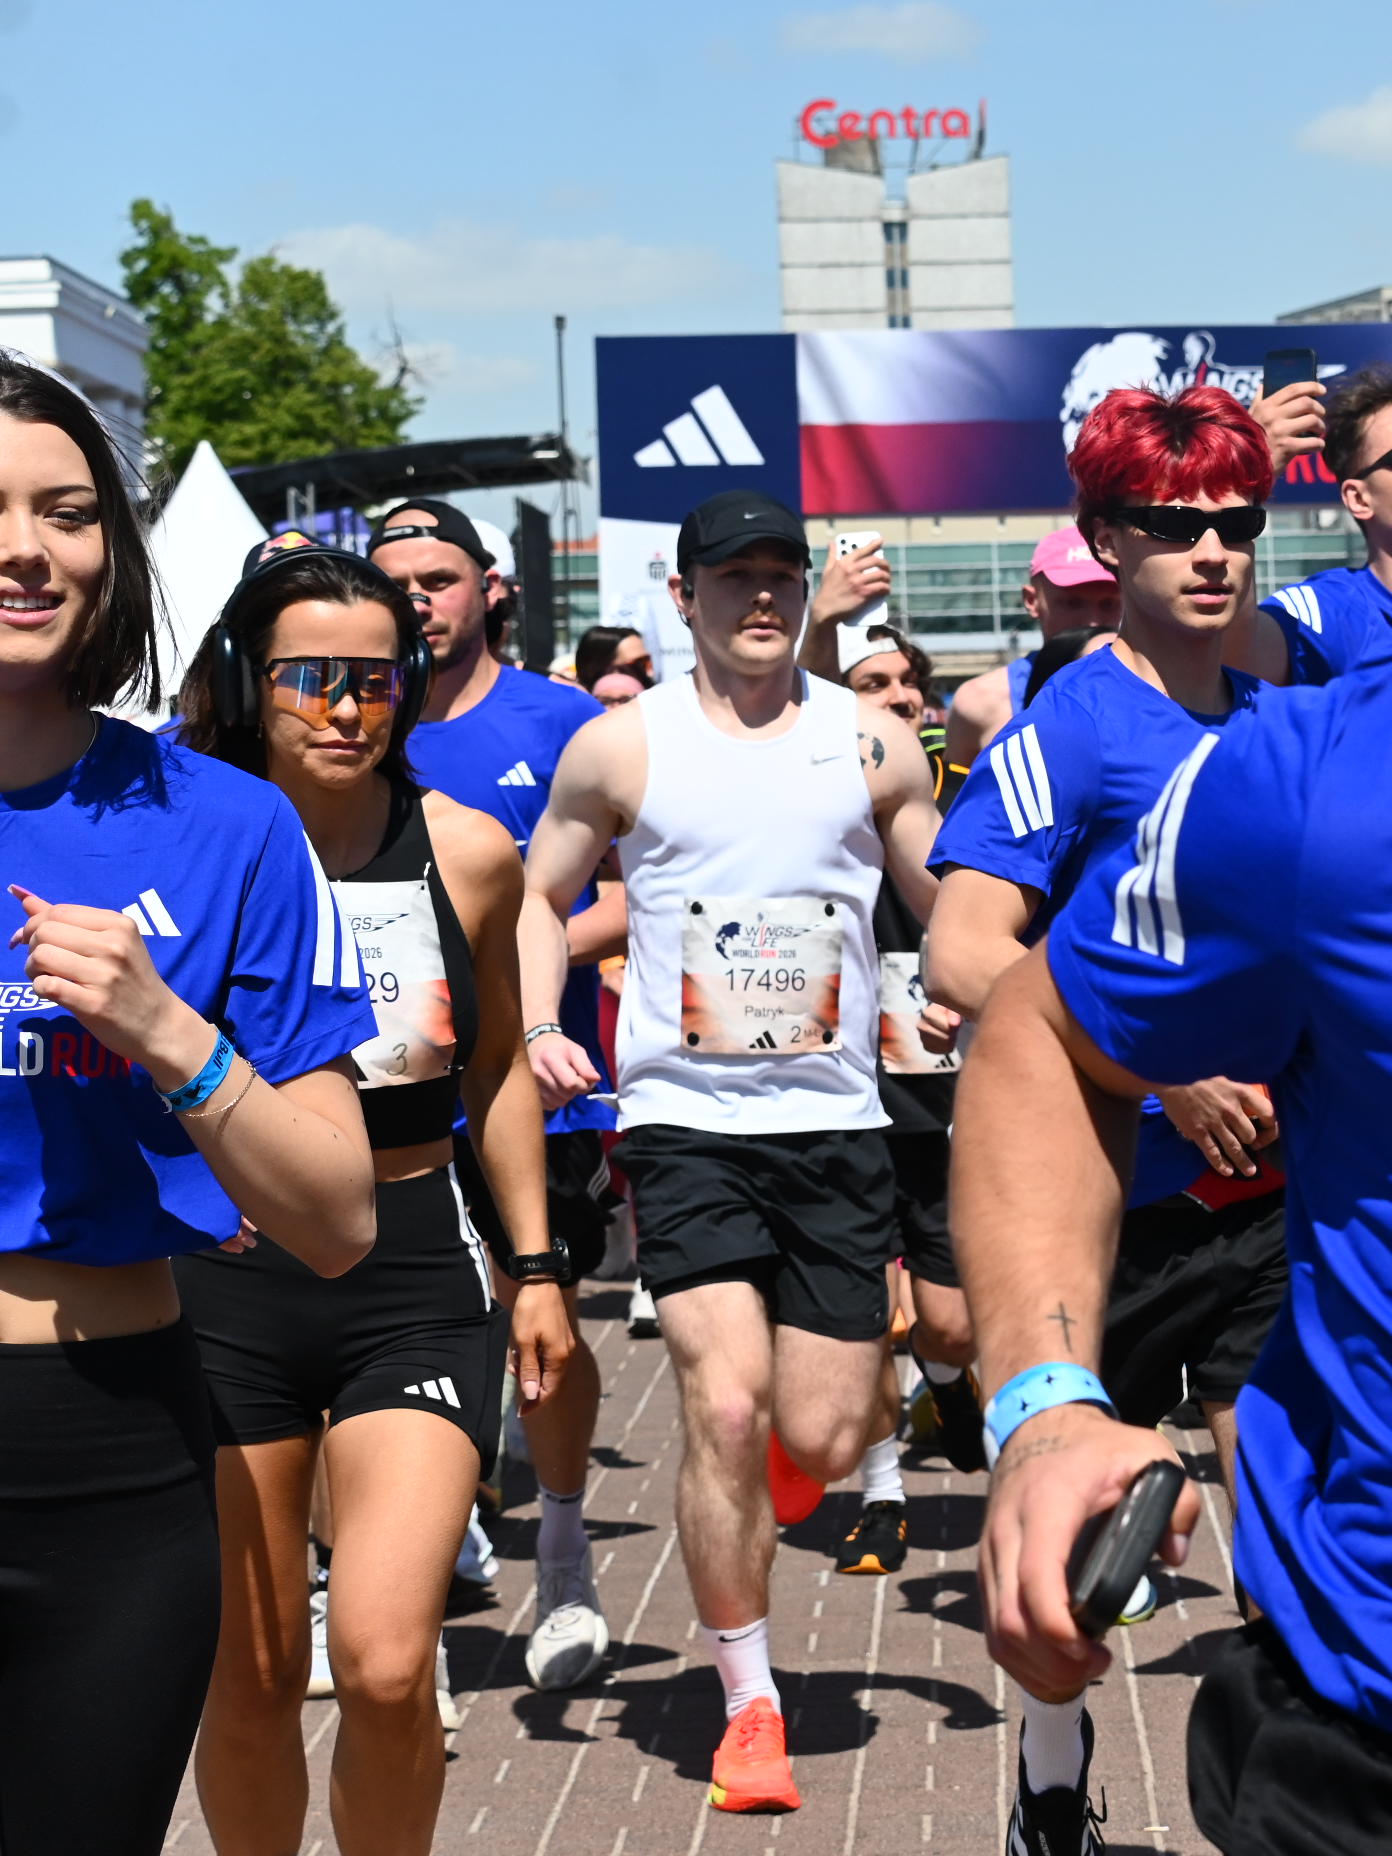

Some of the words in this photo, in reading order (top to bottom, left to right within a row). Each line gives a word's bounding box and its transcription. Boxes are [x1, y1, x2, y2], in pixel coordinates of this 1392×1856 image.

[745, 926, 794, 937] WINGS
[725, 968, 806, 992] 17496
[744, 1005, 785, 1021] Patryk
[790, 1025, 801, 1043] 2
[385, 1043, 408, 1076] 3
